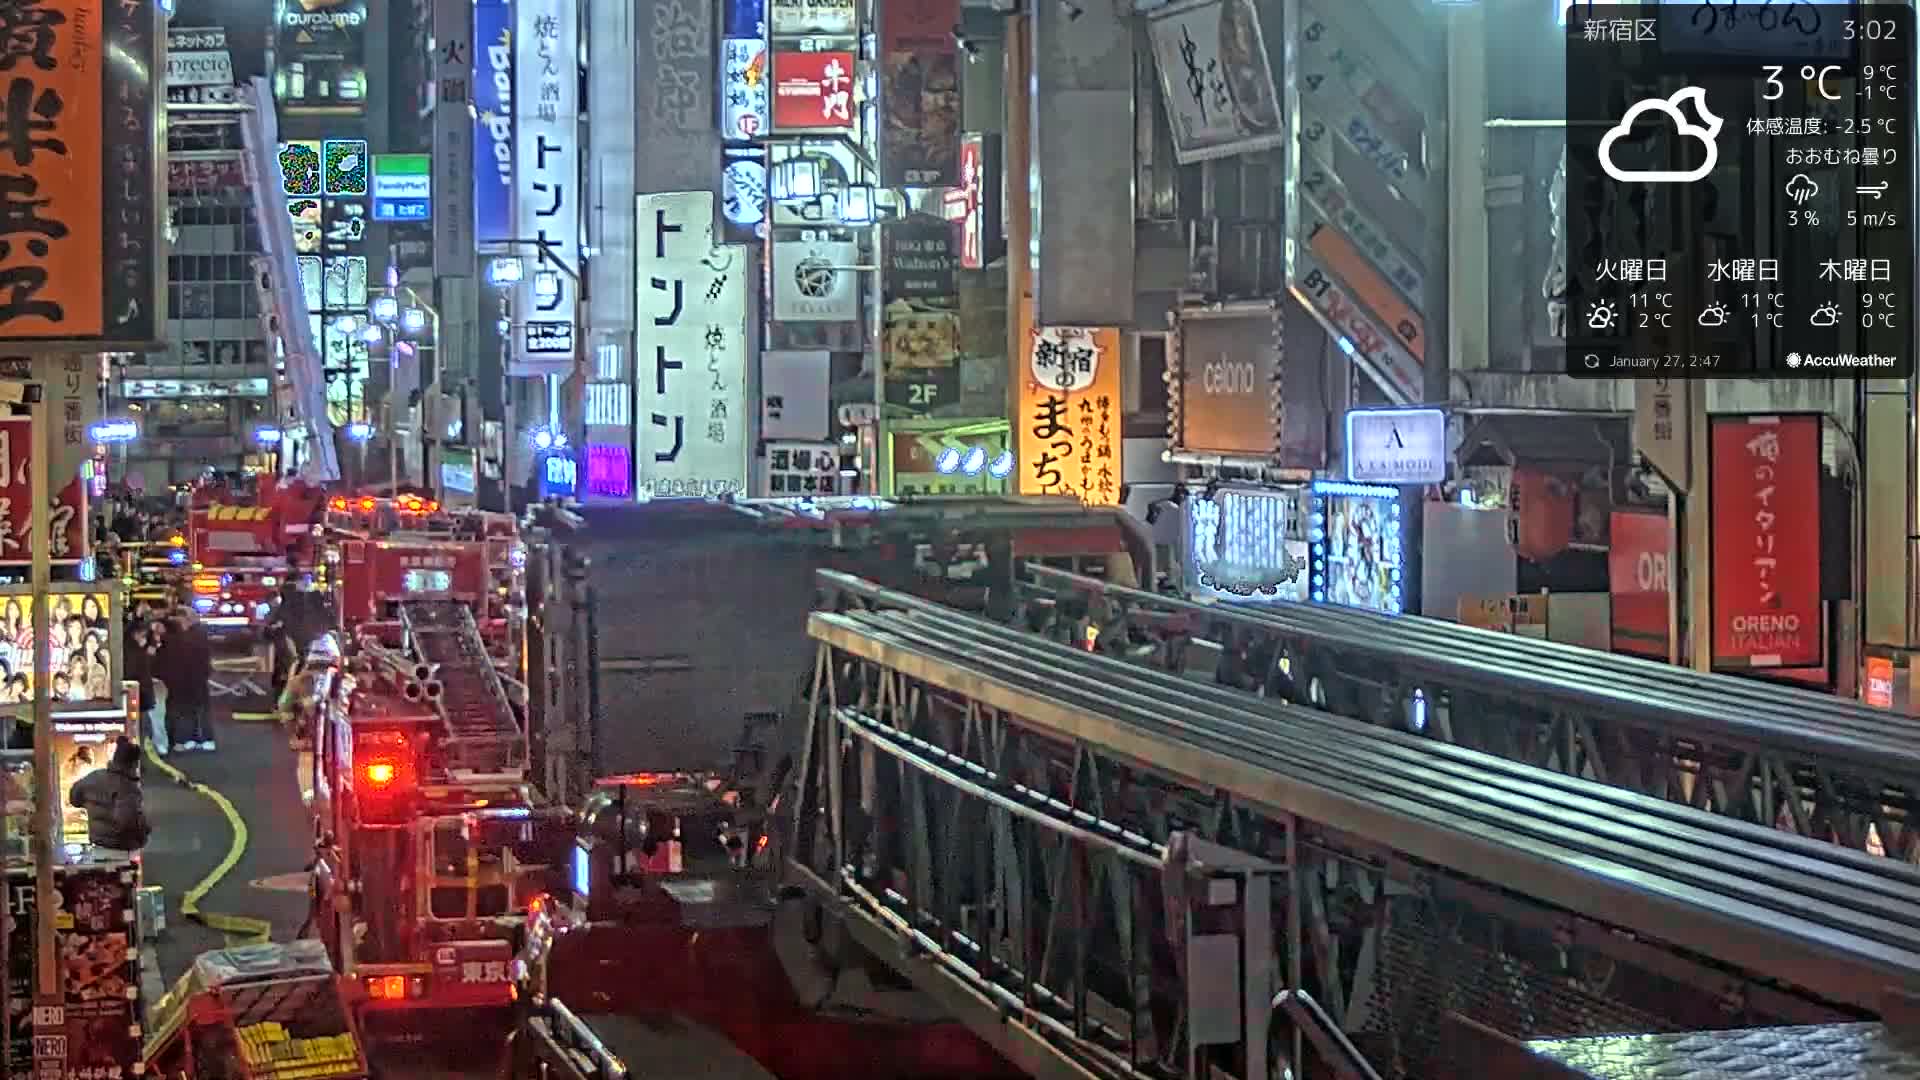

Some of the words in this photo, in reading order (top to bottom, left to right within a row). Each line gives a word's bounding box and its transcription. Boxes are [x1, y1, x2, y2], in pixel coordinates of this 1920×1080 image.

[650, 209, 684, 463] トントン
[908, 384, 938, 404] 2F
[1384, 420, 1404, 449] A
[1745, 431, 1780, 604] 俺のイタリアン
[1637, 551, 1667, 591] OR
[1732, 615, 1800, 633] ORENO
[1731, 635, 1800, 651] ITALIAN
[462, 960, 512, 983] 東京
